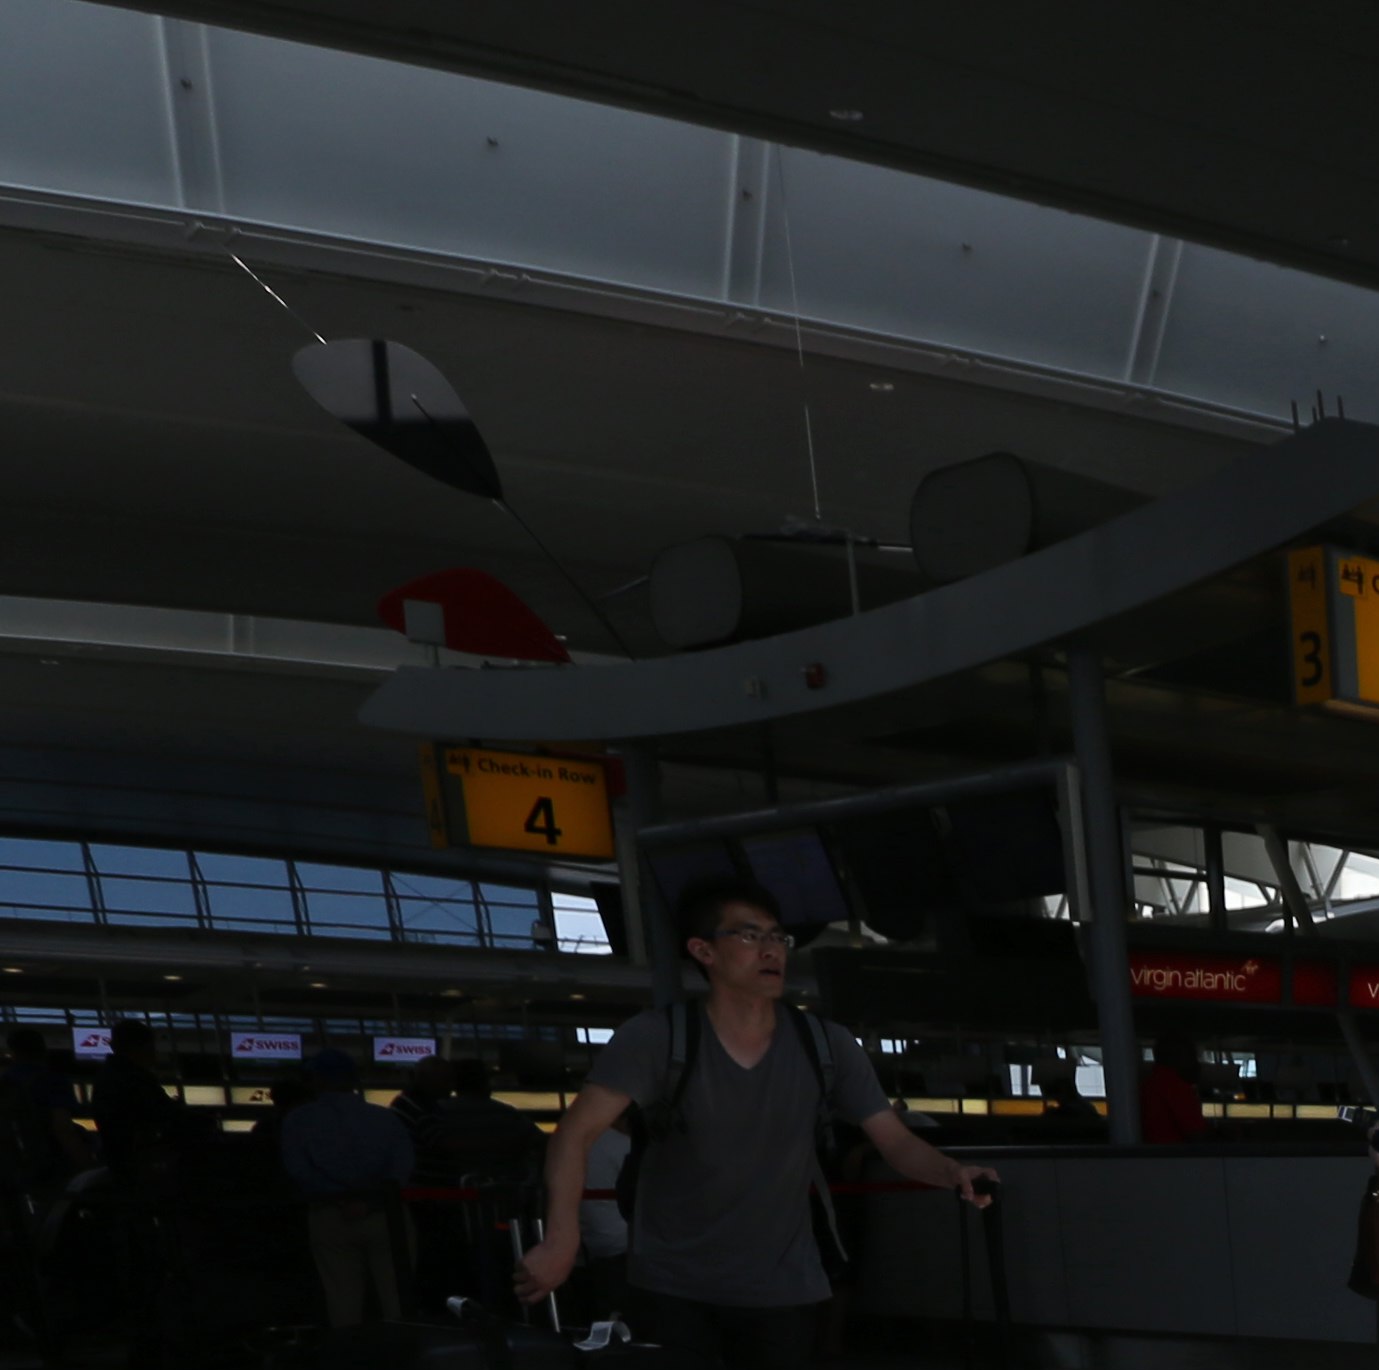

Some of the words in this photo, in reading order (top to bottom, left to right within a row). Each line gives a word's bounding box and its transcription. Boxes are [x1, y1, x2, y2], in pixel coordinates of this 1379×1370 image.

[1301, 630, 1323, 688] 3
[478, 757, 554, 779] Check-in
[558, 766, 598, 785] Row
[524, 796, 562, 845] 4
[1130, 964, 1182, 991] virgin
[1184, 967, 1247, 993] atlantic
[256, 1039, 299, 1051] SWISS
[395, 1044, 432, 1056] SWISS
